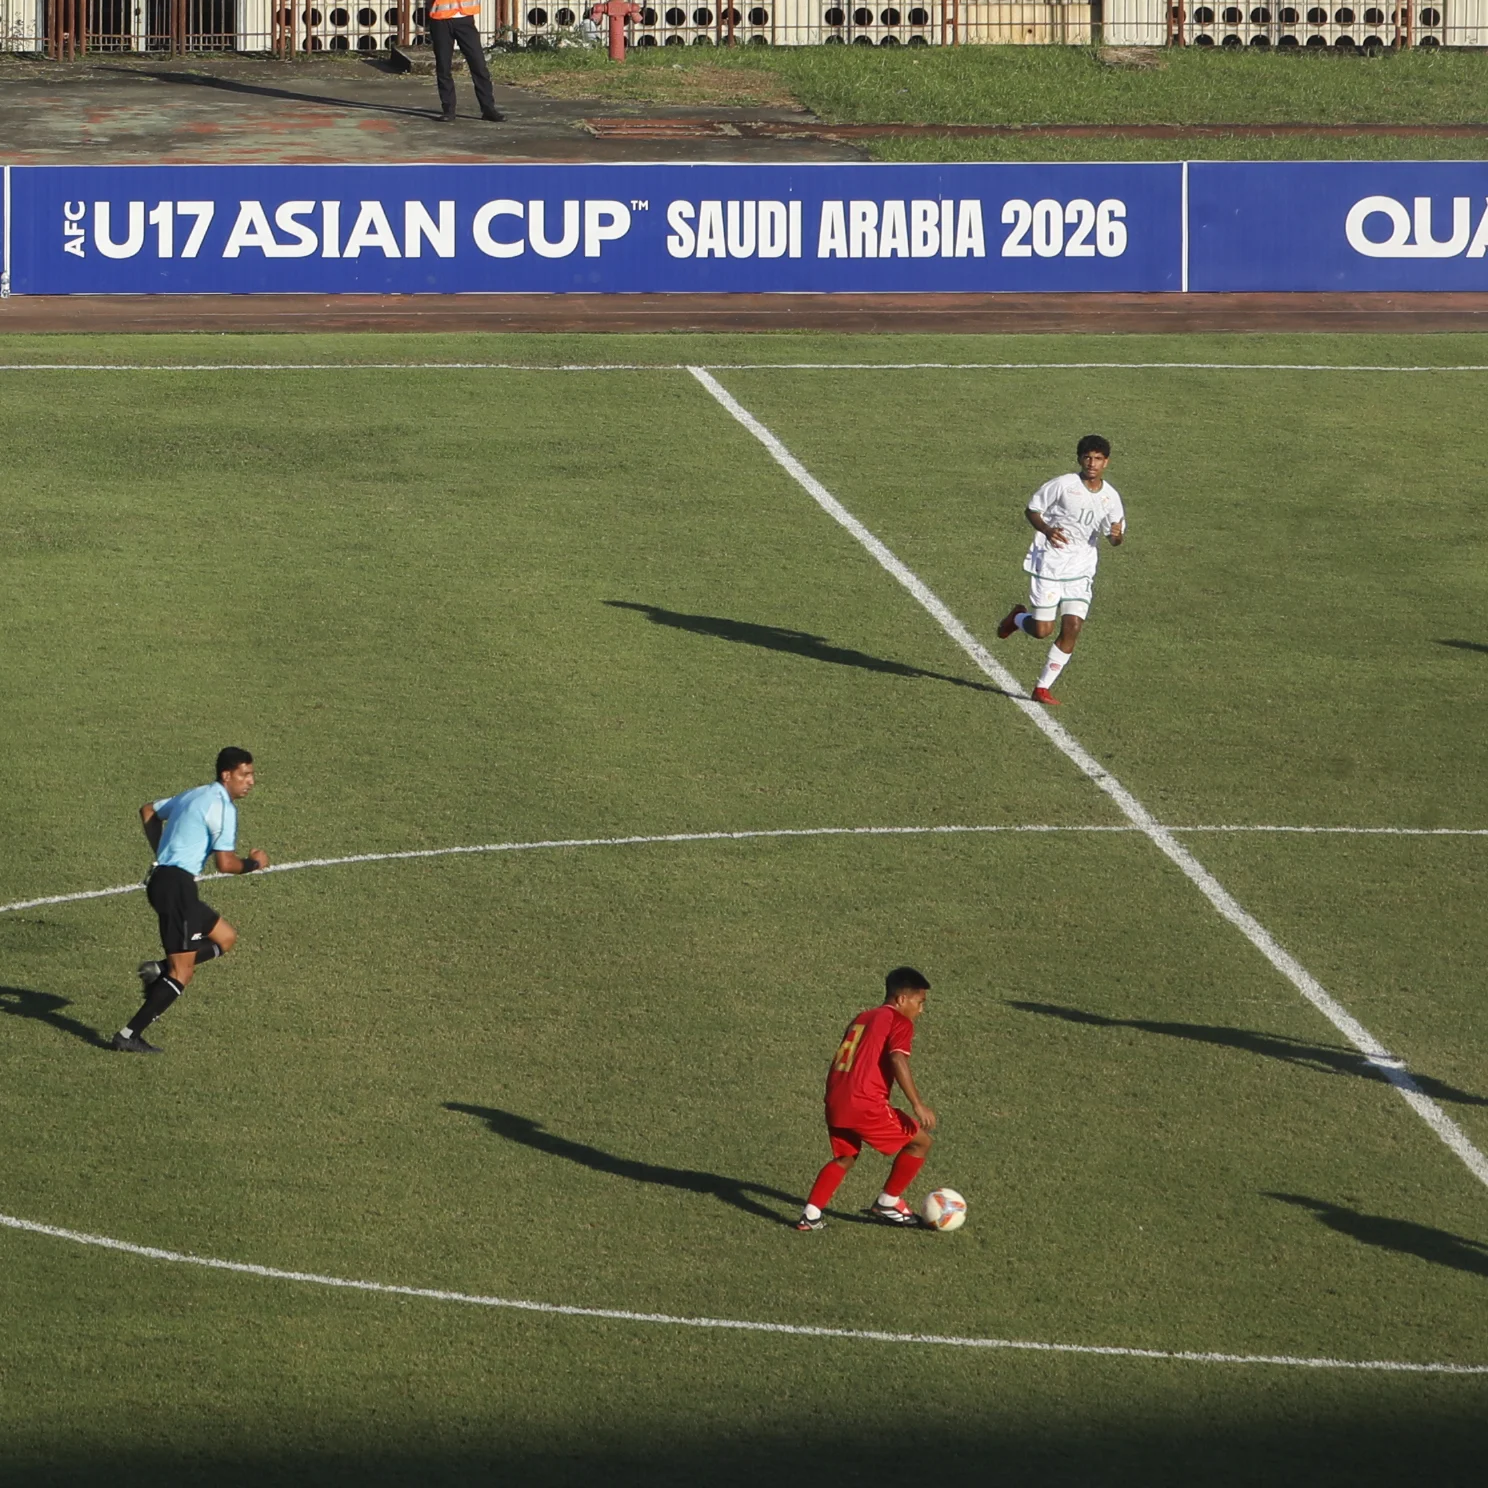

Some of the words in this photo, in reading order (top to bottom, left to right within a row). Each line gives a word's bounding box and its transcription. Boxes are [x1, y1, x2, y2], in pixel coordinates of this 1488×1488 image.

[64, 201, 86, 258] AFC
[94, 200, 215, 259] U17
[222, 200, 455, 258] ASIAN
[666, 199, 802, 259] SAUDI
[817, 199, 986, 258] ARABIA
[1001, 198, 1127, 258] 2026
[1076, 508, 1094, 526] 10
